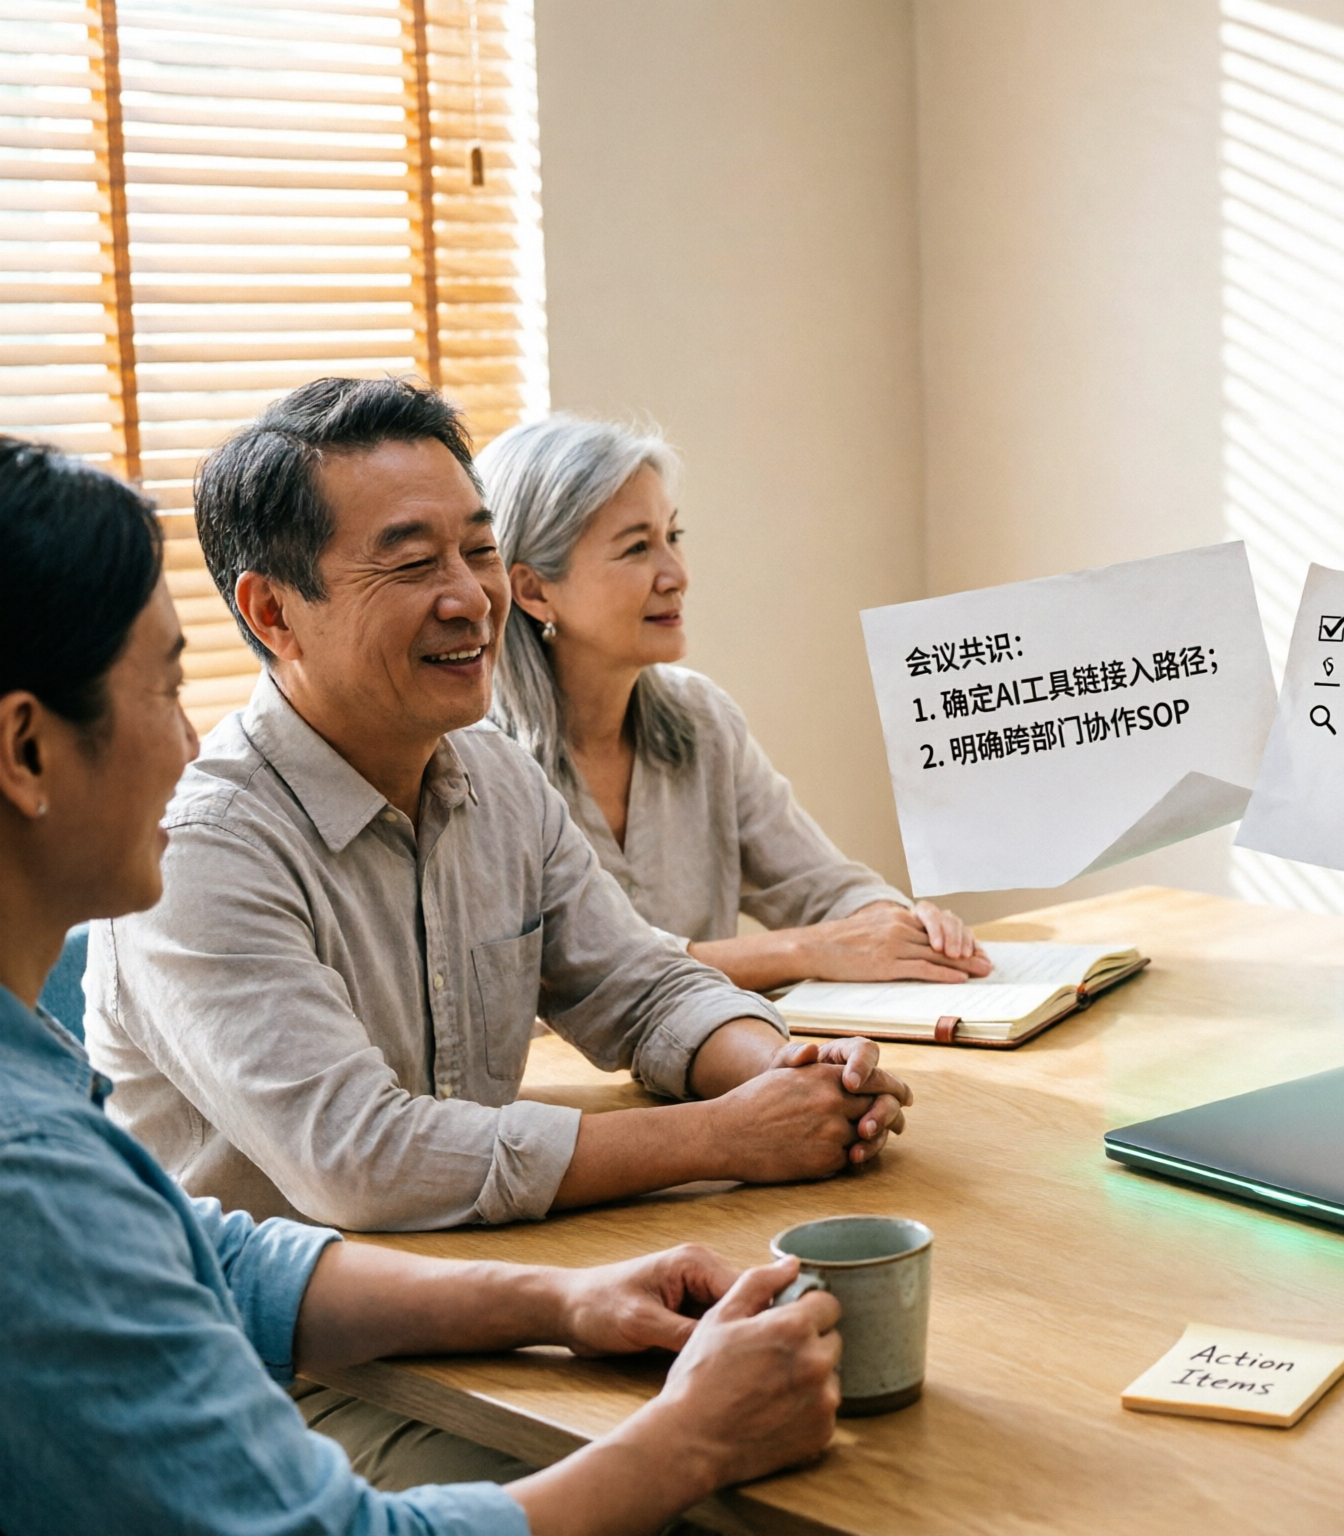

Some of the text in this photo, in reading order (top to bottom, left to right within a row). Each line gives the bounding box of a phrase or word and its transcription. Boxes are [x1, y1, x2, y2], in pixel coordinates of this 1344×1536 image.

[905, 632, 1024, 677] 会议共识：
[913, 645, 1217, 722] 1. 确定AI工具链接入路径；
[920, 699, 1190, 769] 2. 明确跨部门协作SOP
[1189, 1344, 1295, 1373] Action
[1170, 1368, 1274, 1396] Items
